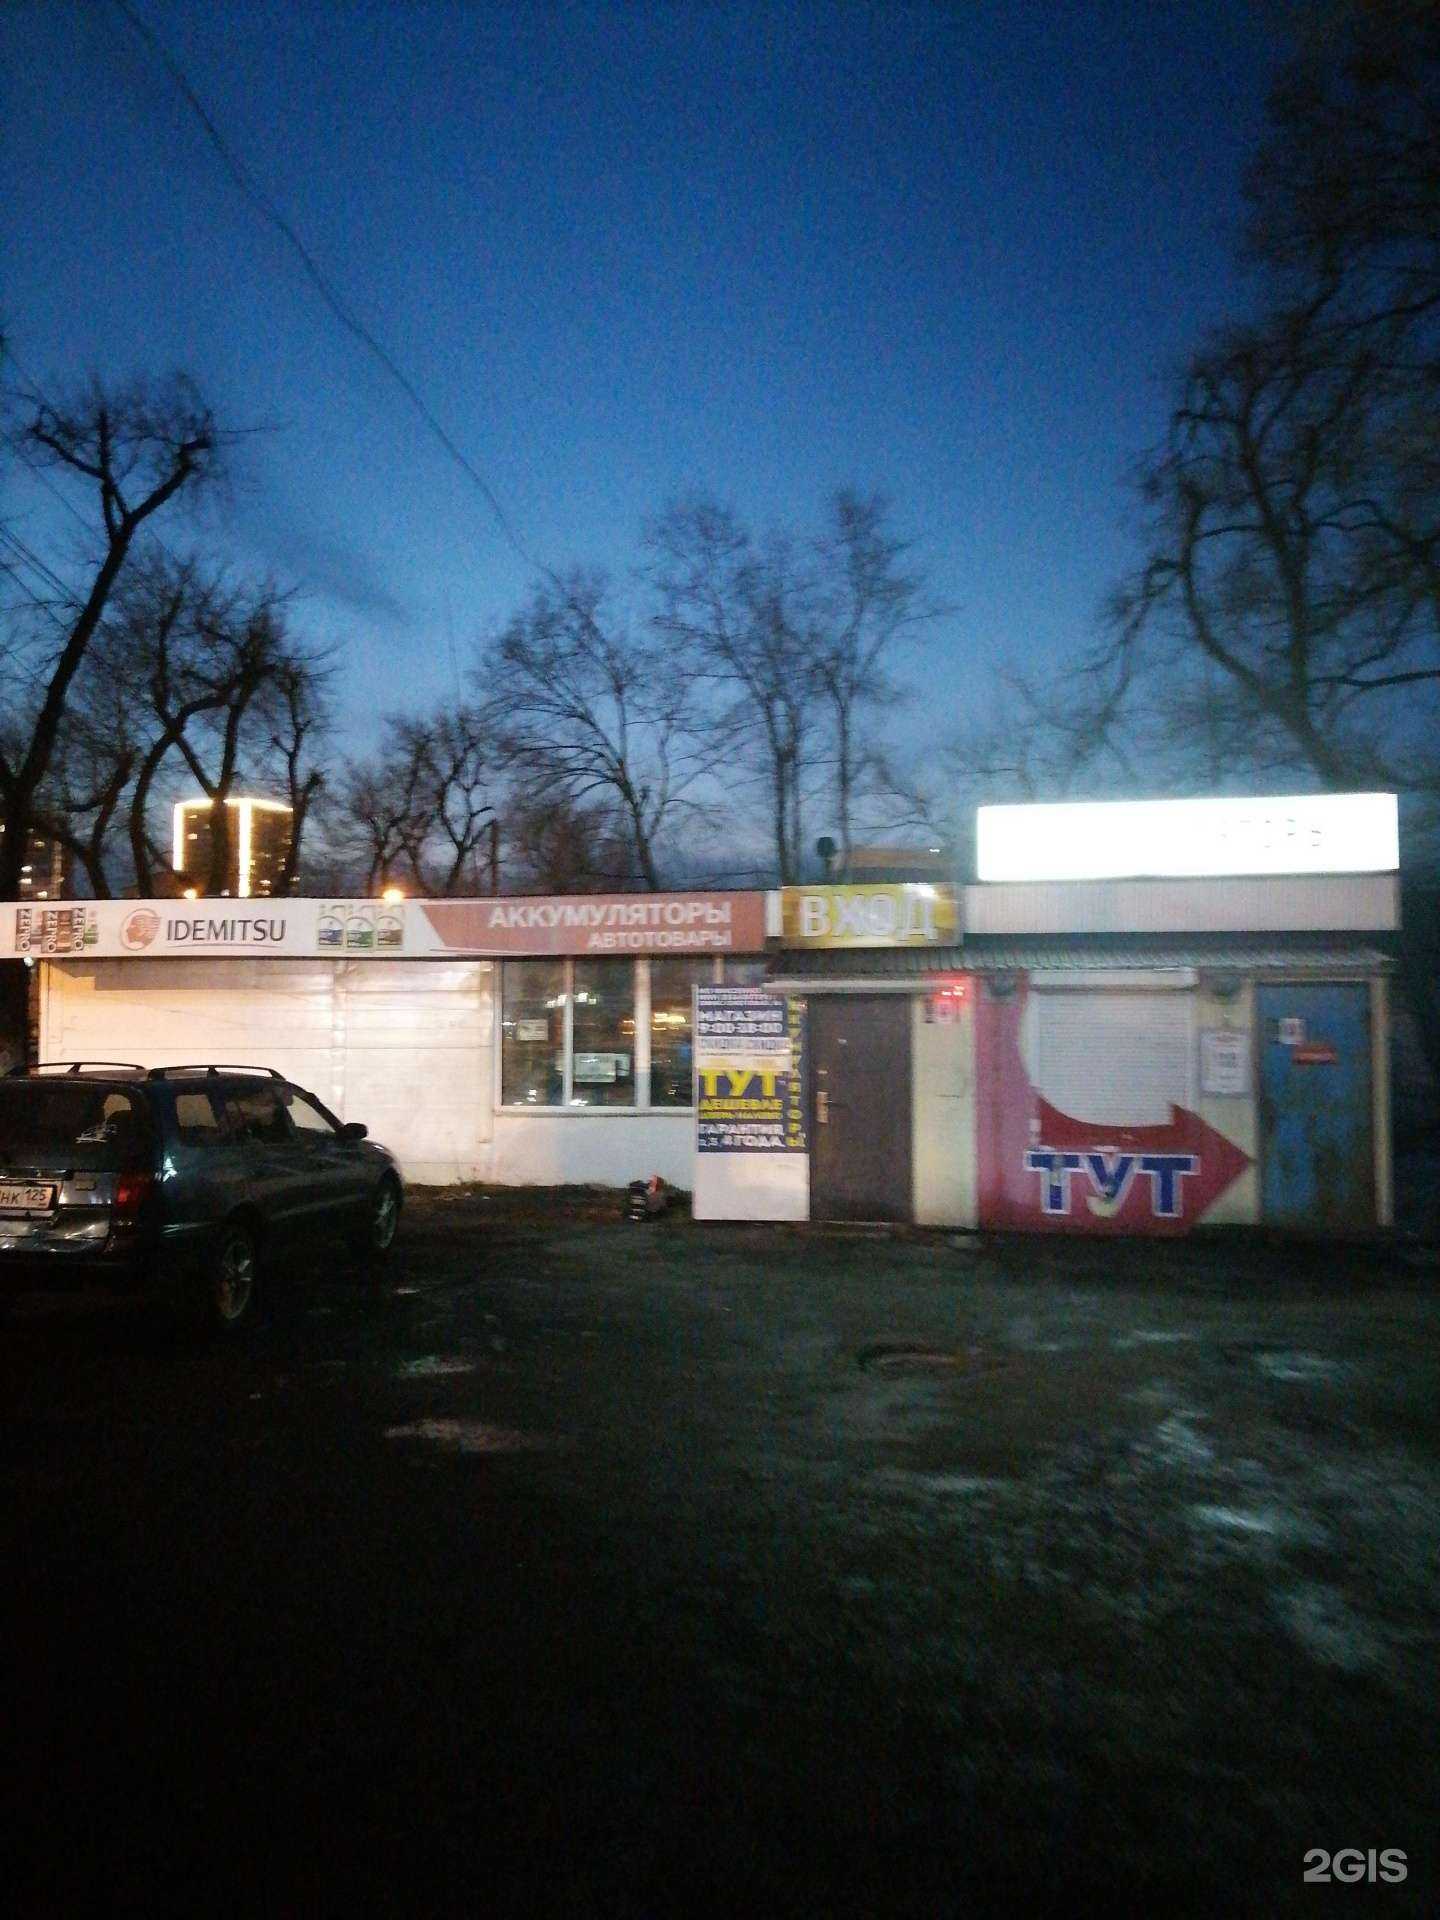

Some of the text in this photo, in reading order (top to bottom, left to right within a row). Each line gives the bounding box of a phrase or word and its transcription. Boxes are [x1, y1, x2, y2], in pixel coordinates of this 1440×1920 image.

[488, 901, 732, 928] АККУМУЛЯТОРЫ
[799, 893, 939, 941] ВХОД
[167, 919, 286, 942] IDEMITSU
[587, 930, 732, 949] АВТОТОВАРЫ
[699, 1069, 784, 1097] ТУТ
[1023, 1148, 1200, 1217] ТУТ
